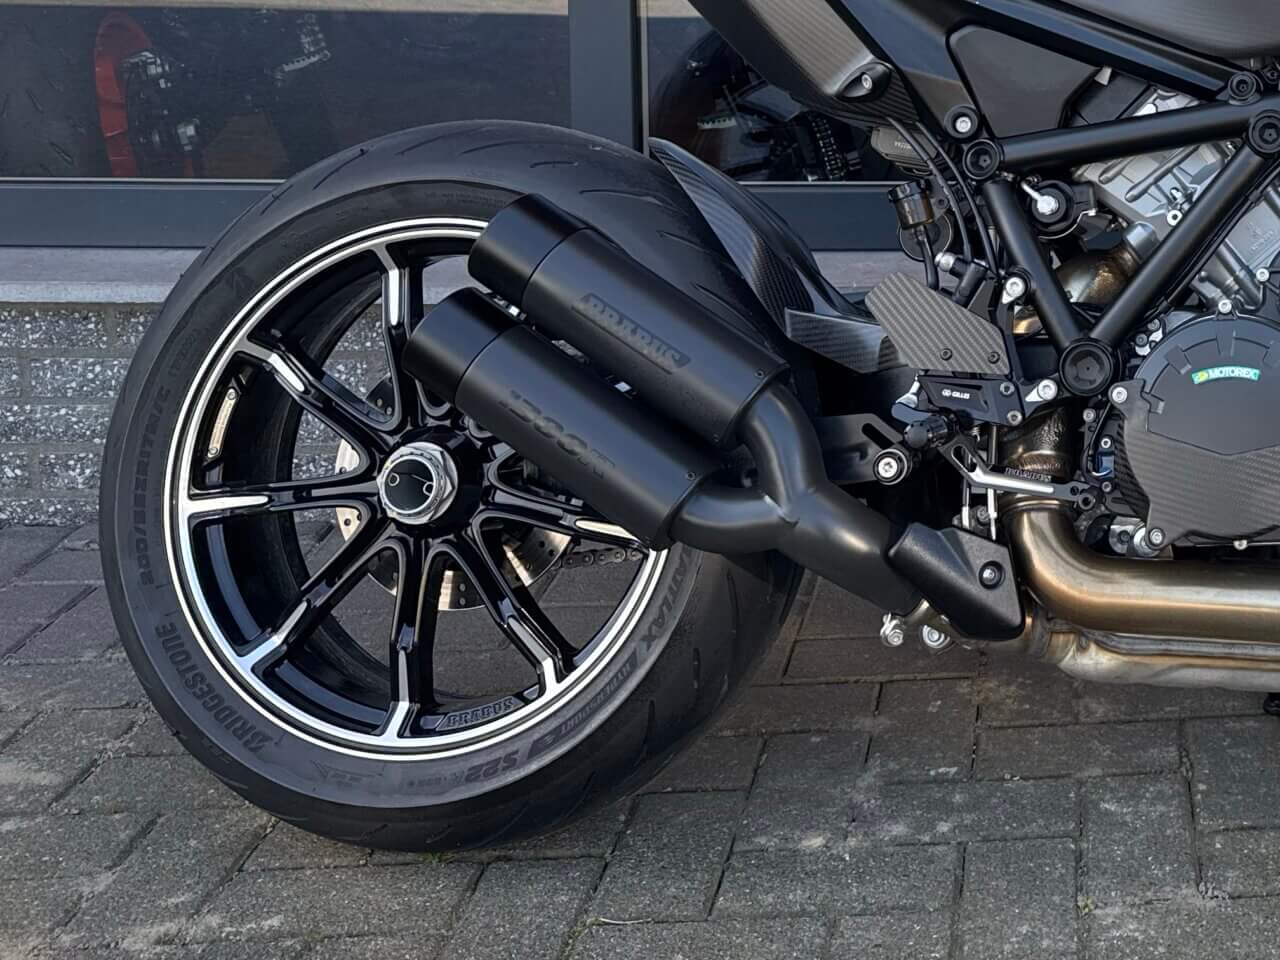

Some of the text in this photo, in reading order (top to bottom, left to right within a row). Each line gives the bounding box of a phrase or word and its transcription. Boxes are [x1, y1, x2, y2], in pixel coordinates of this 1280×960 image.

[1208, 365, 1260, 380] MOTOREX
[155, 621, 270, 752] BRIDGESTONE
[448, 695, 515, 728] BRABUS
